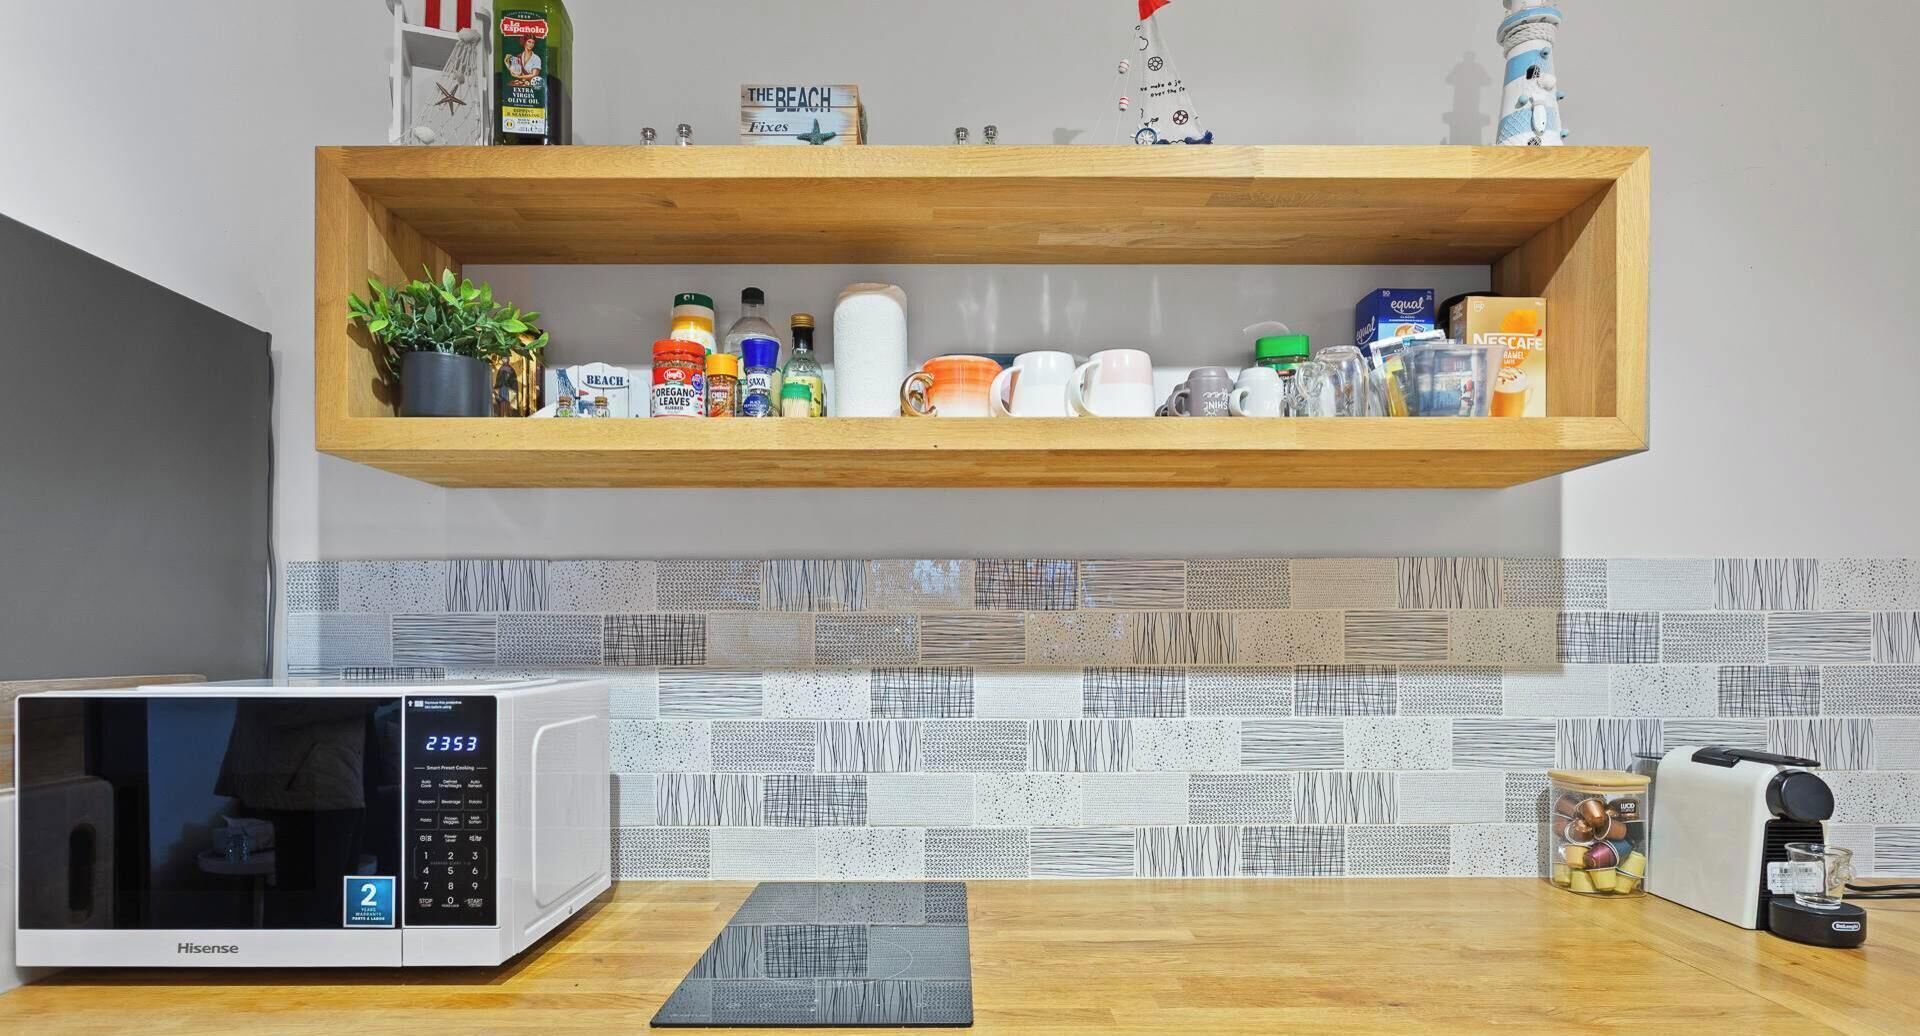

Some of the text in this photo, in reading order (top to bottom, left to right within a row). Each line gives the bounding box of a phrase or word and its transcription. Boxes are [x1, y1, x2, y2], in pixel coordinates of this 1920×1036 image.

[504, 24, 545, 33] Española
[748, 87, 831, 112] THE BEACH
[749, 121, 789, 132] Fixes
[1391, 297, 1425, 313] equal
[1503, 350, 1525, 360] RAMEL
[586, 375, 624, 386] BEACH
[749, 377, 766, 387] SAXA
[656, 387, 695, 398] OREGANO
[660, 397, 691, 406] LEAVES
[426, 736, 477, 751] 2353
[424, 851, 478, 860] 1 2 3
[423, 867, 478, 875] 4 5 6
[424, 882, 478, 890] 7 8 9
[361, 883, 377, 906] 2
[447, 896, 454, 905] 0
[177, 942, 240, 954] Hisense
